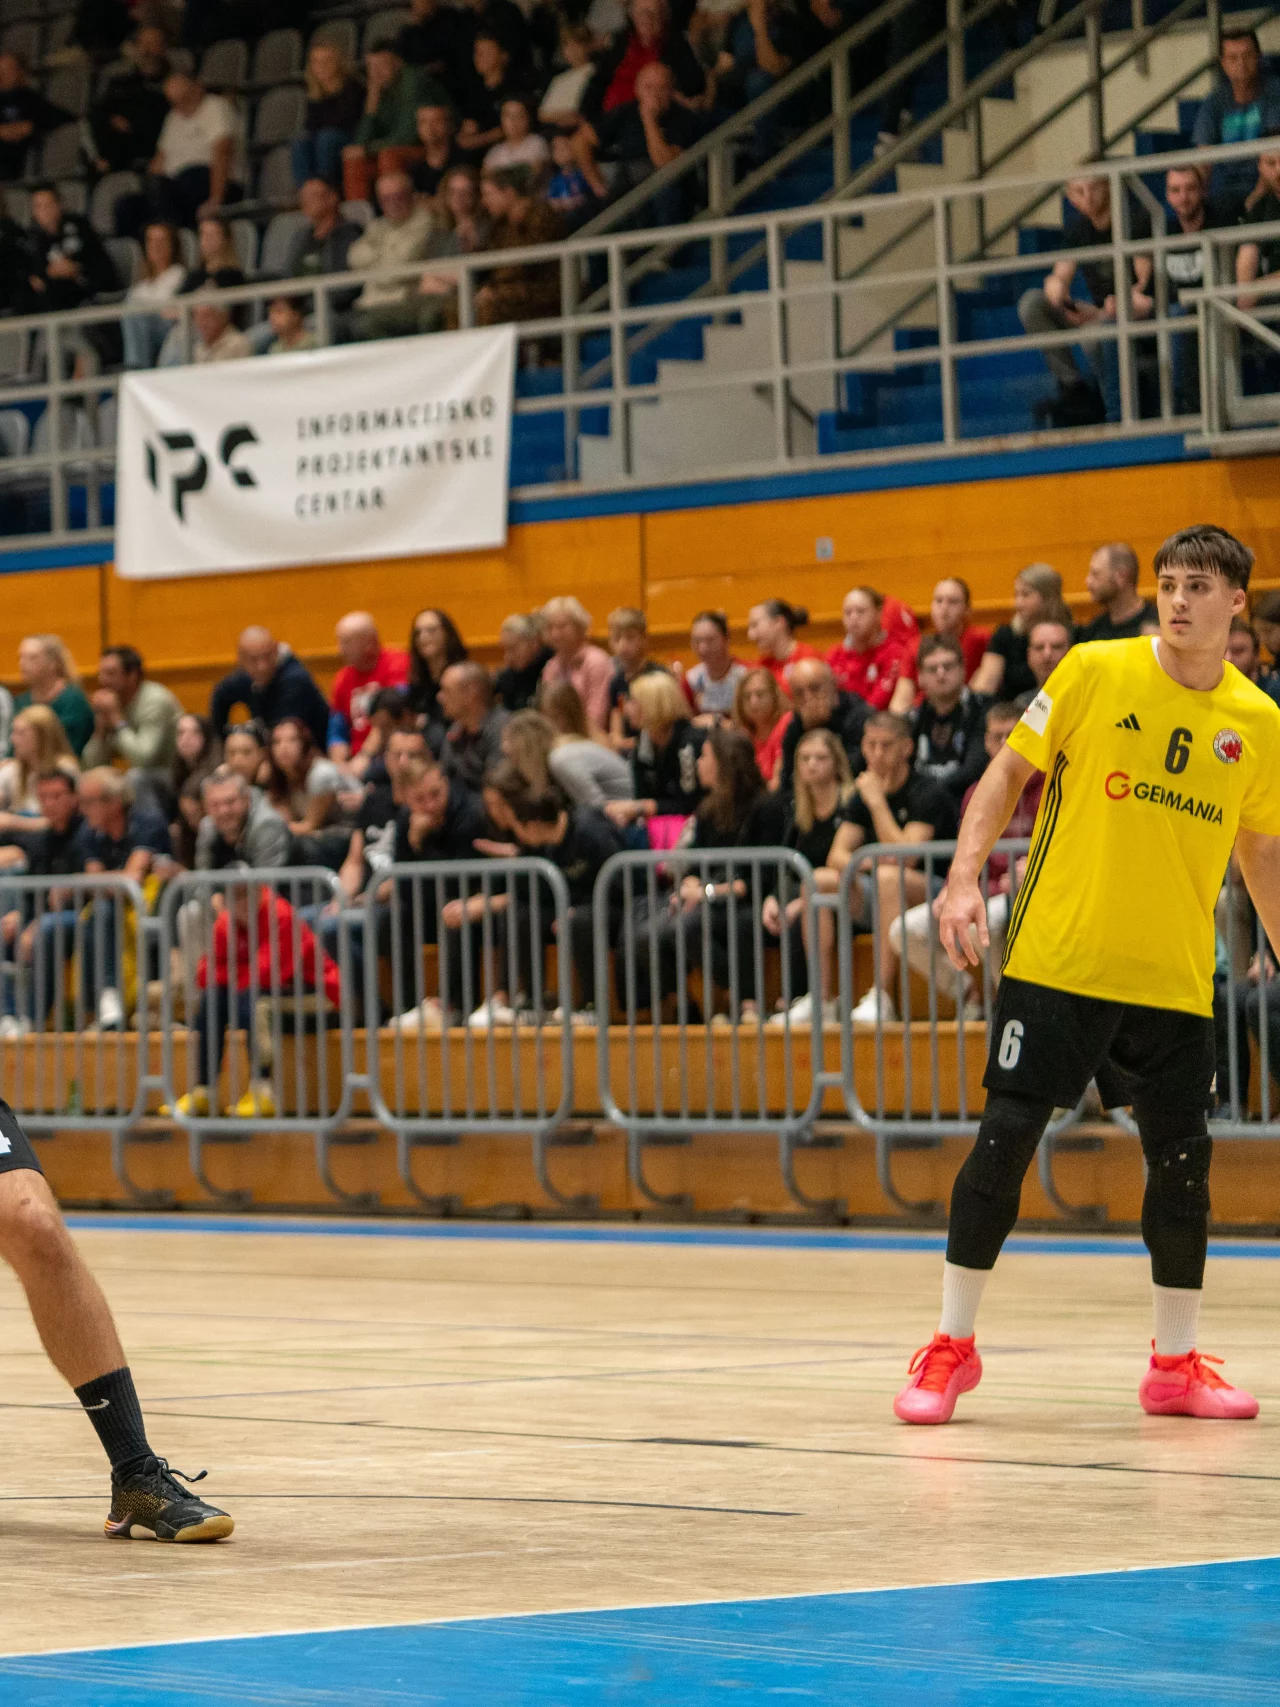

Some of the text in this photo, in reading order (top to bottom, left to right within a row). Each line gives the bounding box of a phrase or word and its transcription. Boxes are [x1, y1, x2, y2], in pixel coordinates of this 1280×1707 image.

[297, 394, 495, 440] INFORMACIJSKO
[296, 435, 494, 479] PROJEKTANTSKI
[295, 487, 386, 518] CENTAR
[1165, 727, 1193, 775] 6
[998, 1019, 1024, 1070] 6
